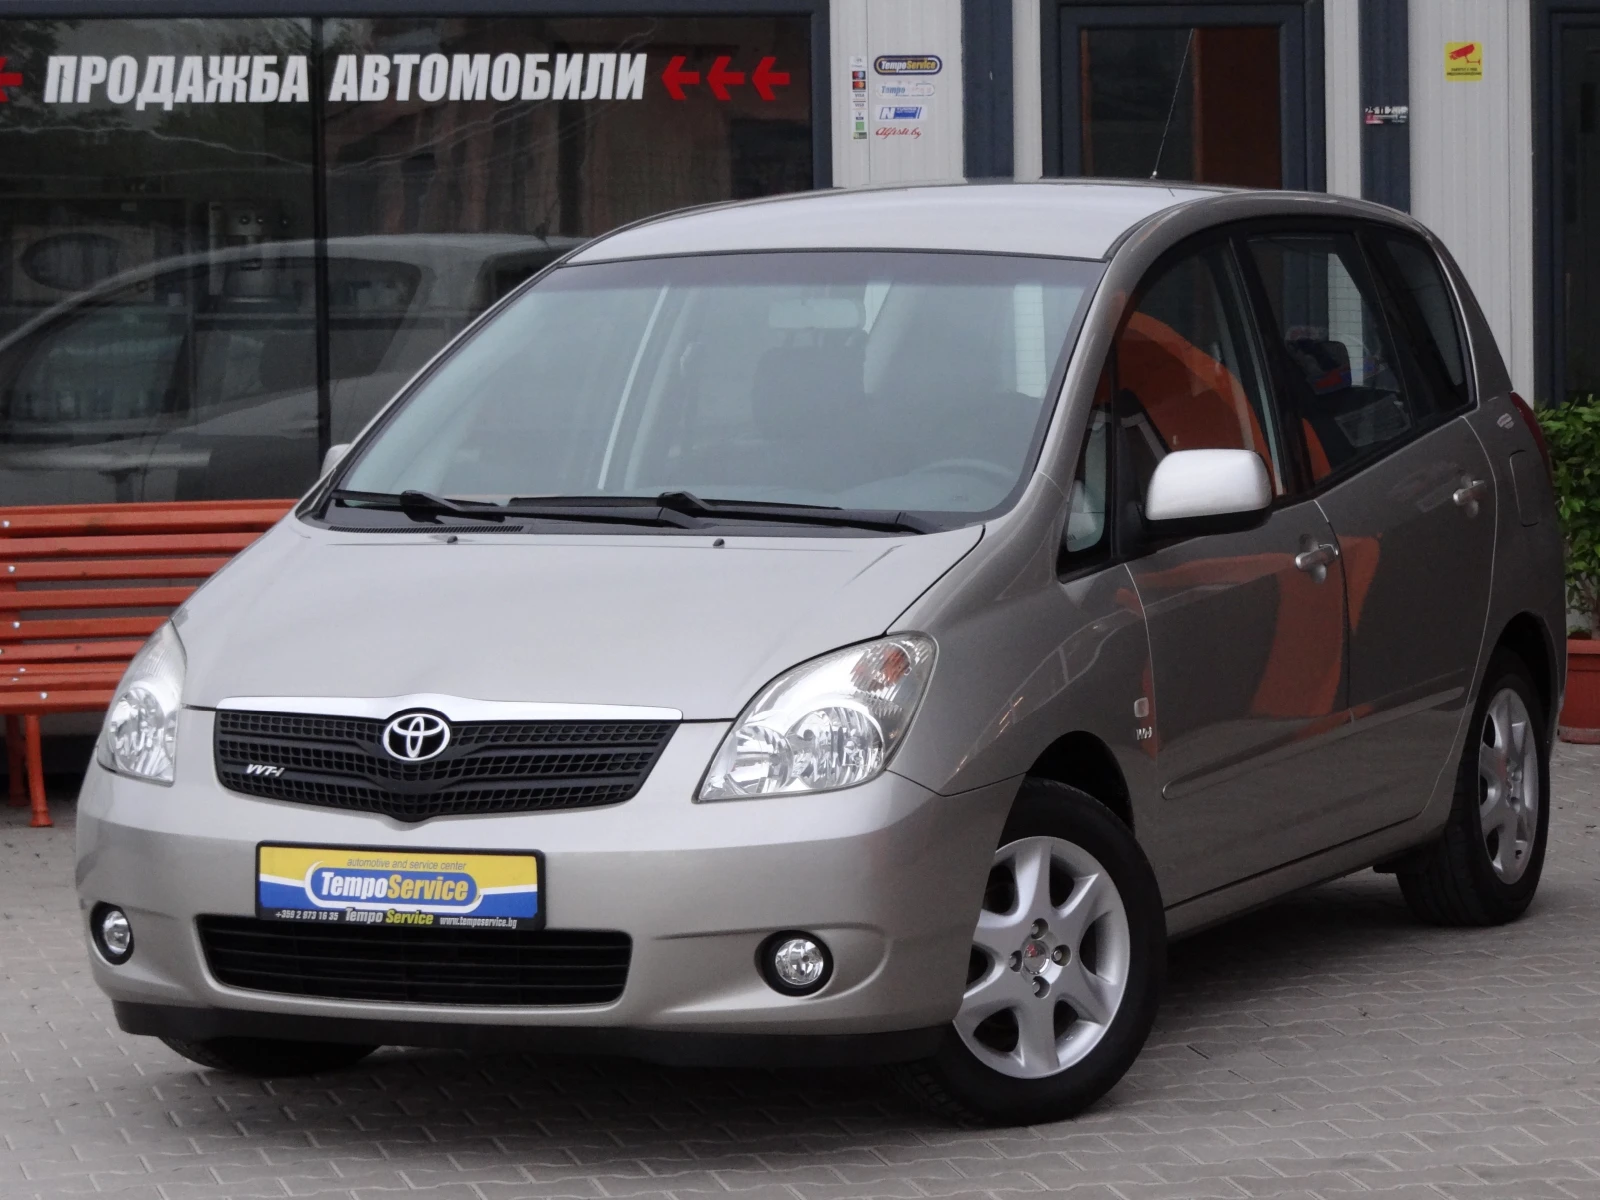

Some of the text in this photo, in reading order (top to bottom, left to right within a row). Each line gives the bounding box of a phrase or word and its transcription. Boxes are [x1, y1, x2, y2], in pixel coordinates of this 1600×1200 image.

[44, 53, 647, 111] ПРОДАЖБА АВТОМОБИЛИ
[347, 857, 466, 871] automotive and service center
[322, 871, 469, 901] TempoService
[275, 910, 295, 919] +359
[296, 911, 301, 919] 2
[329, 912, 339, 921] 35
[345, 907, 383, 924] Tempo
[385, 909, 434, 925] Service
[440, 916, 518, 929] www.temposervice.bg
